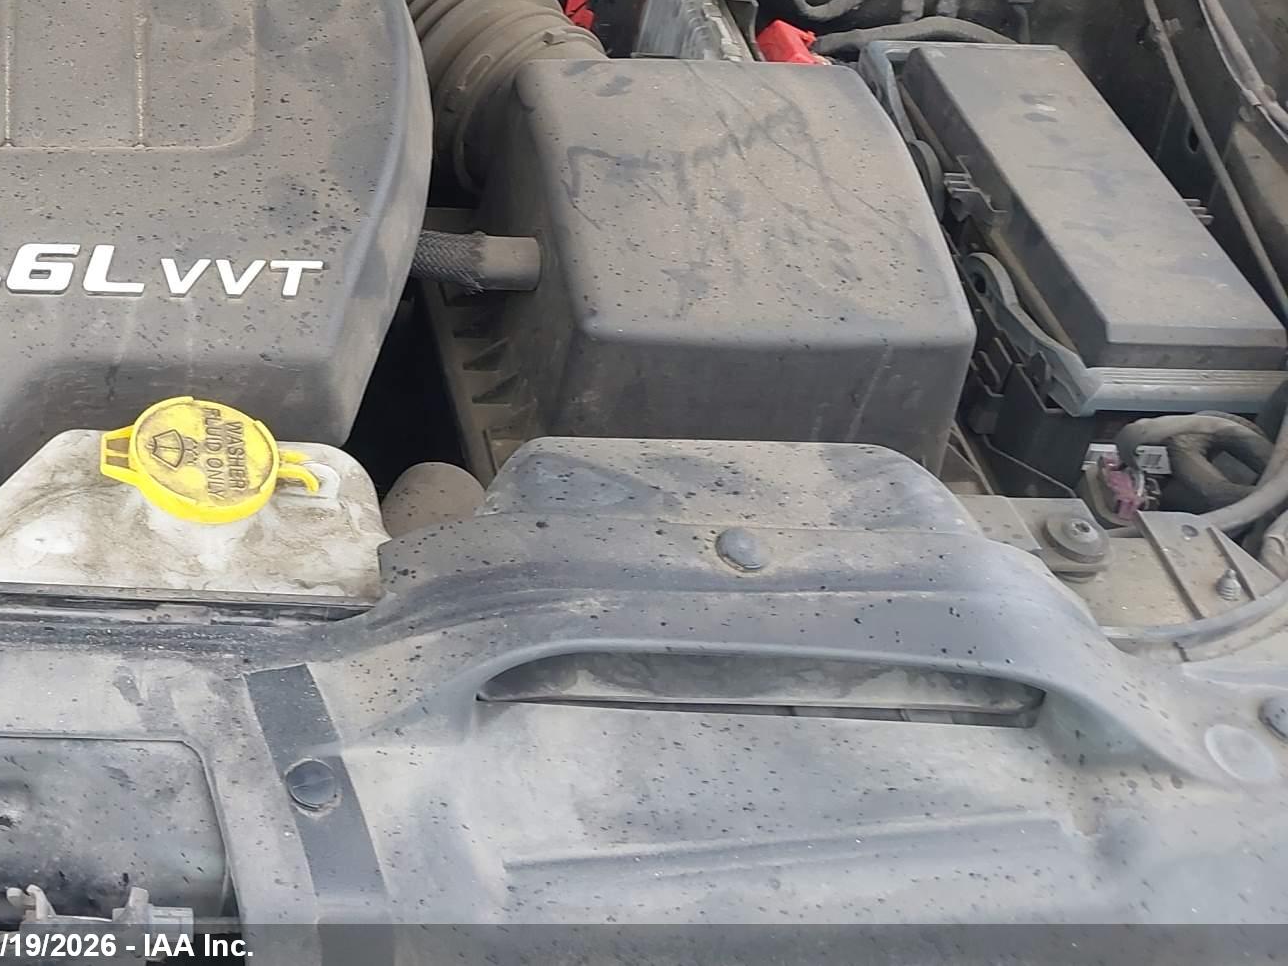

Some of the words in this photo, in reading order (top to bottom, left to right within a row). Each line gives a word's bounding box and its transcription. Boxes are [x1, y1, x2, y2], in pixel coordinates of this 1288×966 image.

[161, 258, 325, 299] VVT
[202, 407, 223, 452] FLUID
[224, 421, 249, 491] WASHER
[206, 457, 225, 501] ONLY
